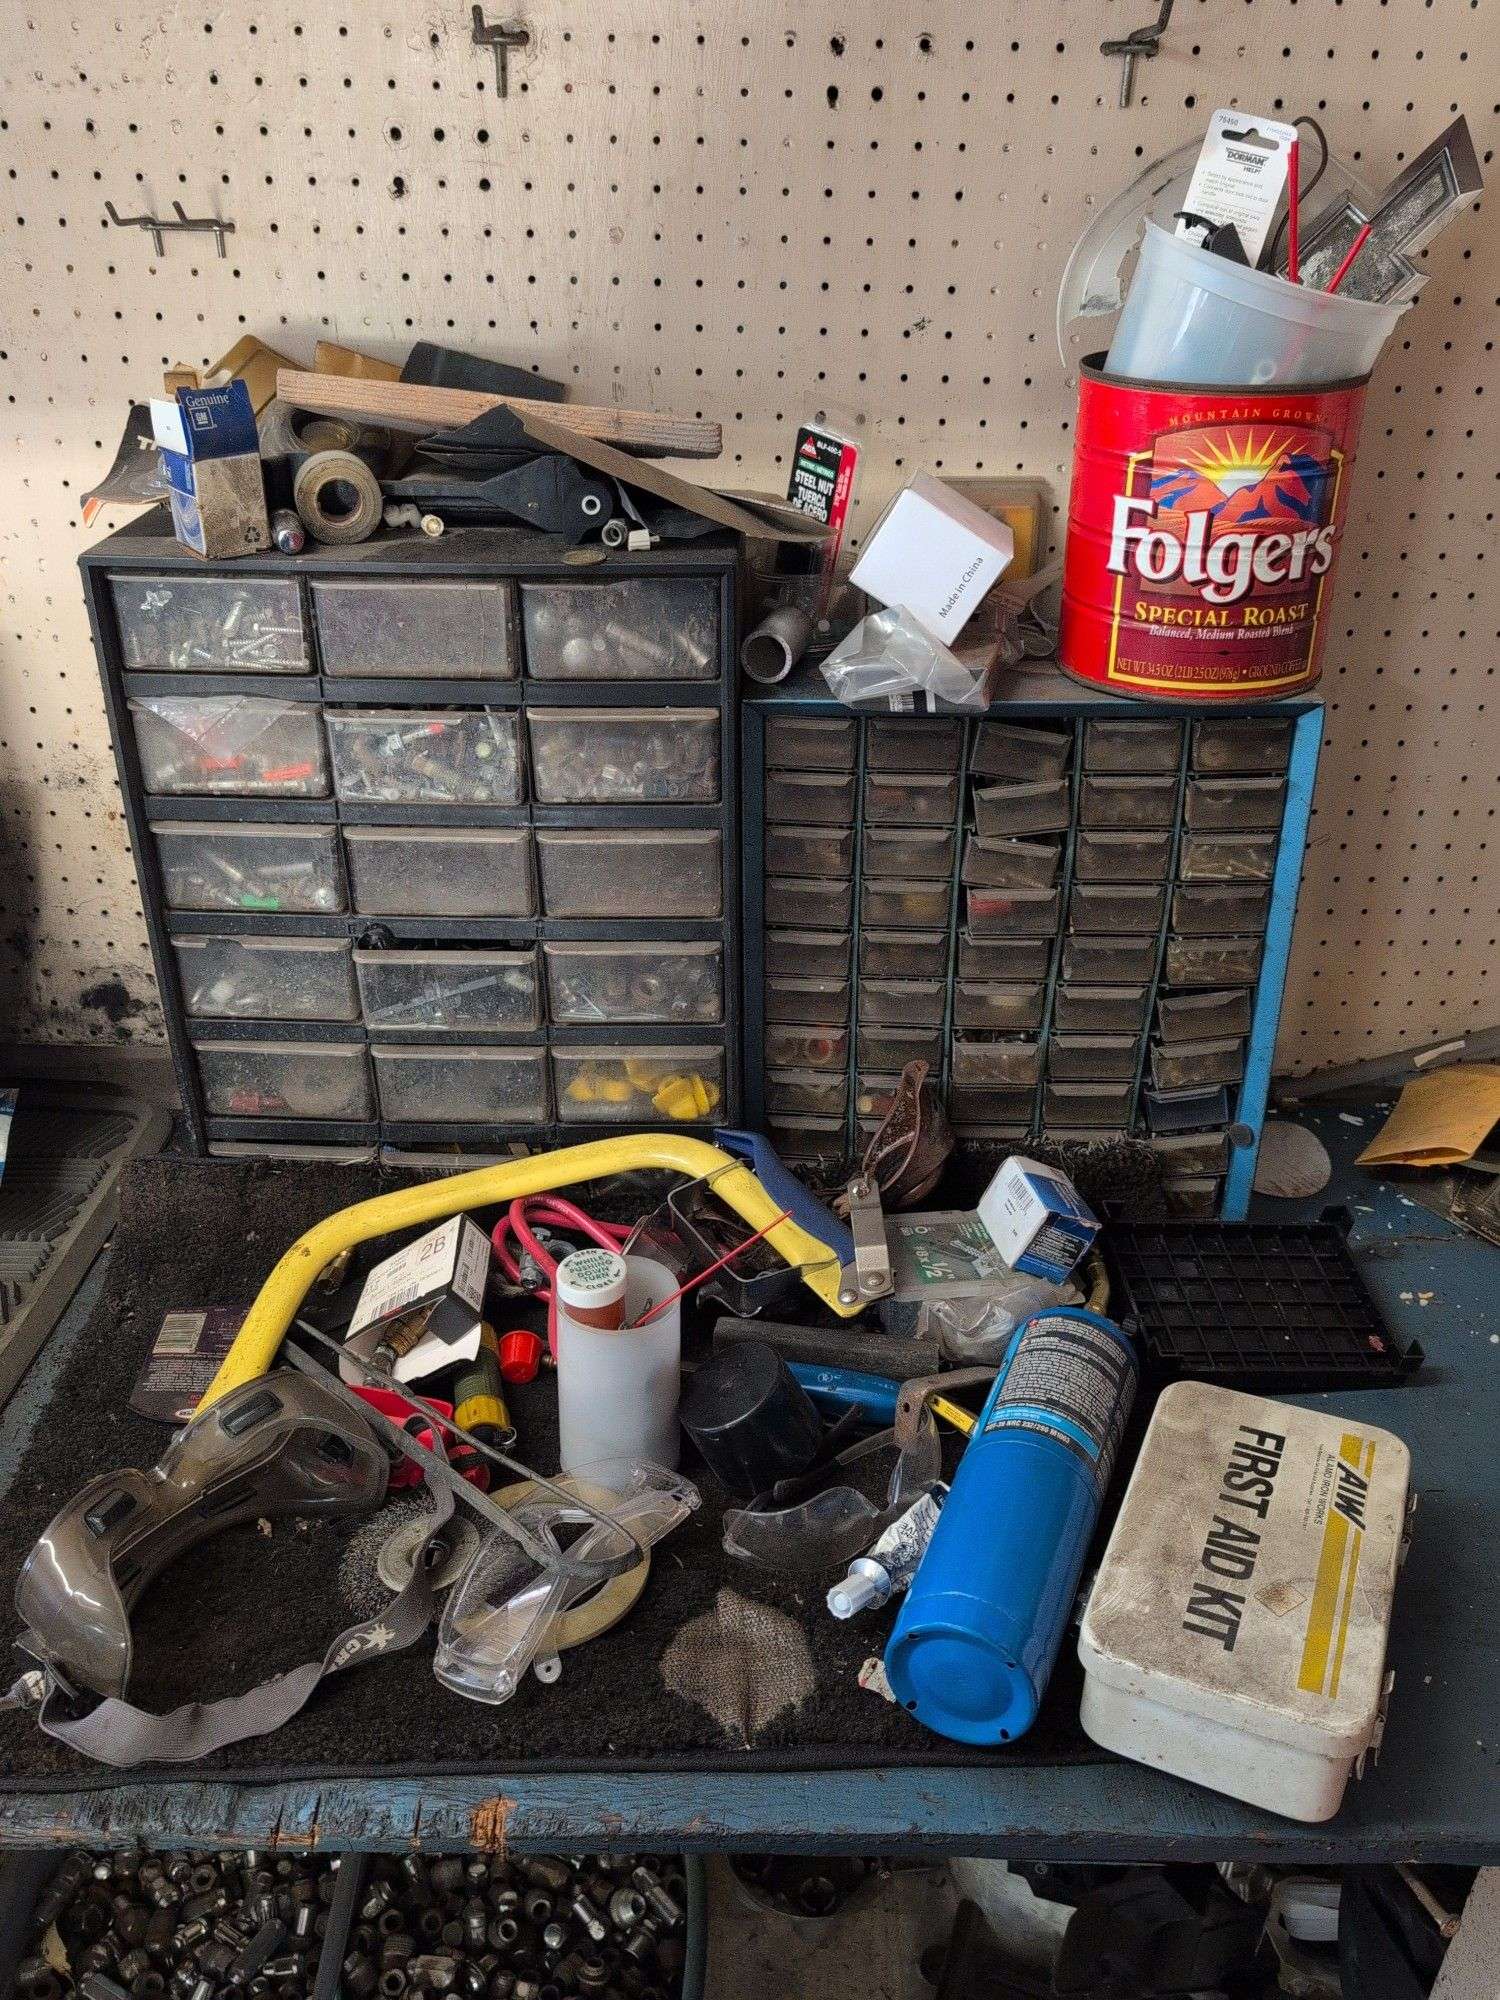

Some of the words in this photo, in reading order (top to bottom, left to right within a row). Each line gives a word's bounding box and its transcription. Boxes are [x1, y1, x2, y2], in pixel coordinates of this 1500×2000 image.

[1226, 150, 1266, 167] DORMAN
[185, 394, 231, 408] Genuine
[195, 412, 208, 424] GM
[1168, 408, 1261, 427] MOUNTAIN
[1272, 409, 1322, 424] GROWN
[795, 469, 817, 490] STEEL
[817, 478, 835, 496] NUT
[792, 496, 803, 508] DE
[803, 502, 828, 522] ACERO
[798, 486, 827, 511] TUERCA
[1106, 494, 1337, 604] Folgers
[938, 593, 960, 618] Made
[956, 583, 967, 594] in
[962, 557, 984, 583] China
[1134, 600, 1234, 627] SPECIAL
[1243, 602, 1309, 627] ROAST
[1150, 624, 1194, 641] Balanced,
[1196, 626, 1234, 641] Medium
[1236, 625, 1271, 641] Roasted
[1117, 657, 1132, 670] NET
[1132, 658, 1148, 673] WT
[420, 1235, 446, 1262] 2B
[574, 1250, 597, 1258] OPEN
[575, 1254, 603, 1266] WHILE
[569, 1259, 613, 1273] PUSHING
[577, 1266, 609, 1278] DOWN
[583, 1272, 610, 1282] TURN
[1219, 1425, 1286, 1519] FIRST
[1323, 1453, 1336, 1479] ALAMO
[1319, 1479, 1331, 1498] IRON
[1333, 1460, 1368, 1532] AIW
[1313, 1498, 1328, 1525] WORKS
[1201, 1516, 1262, 1581] AID
[1182, 1582, 1247, 1652] KIT
